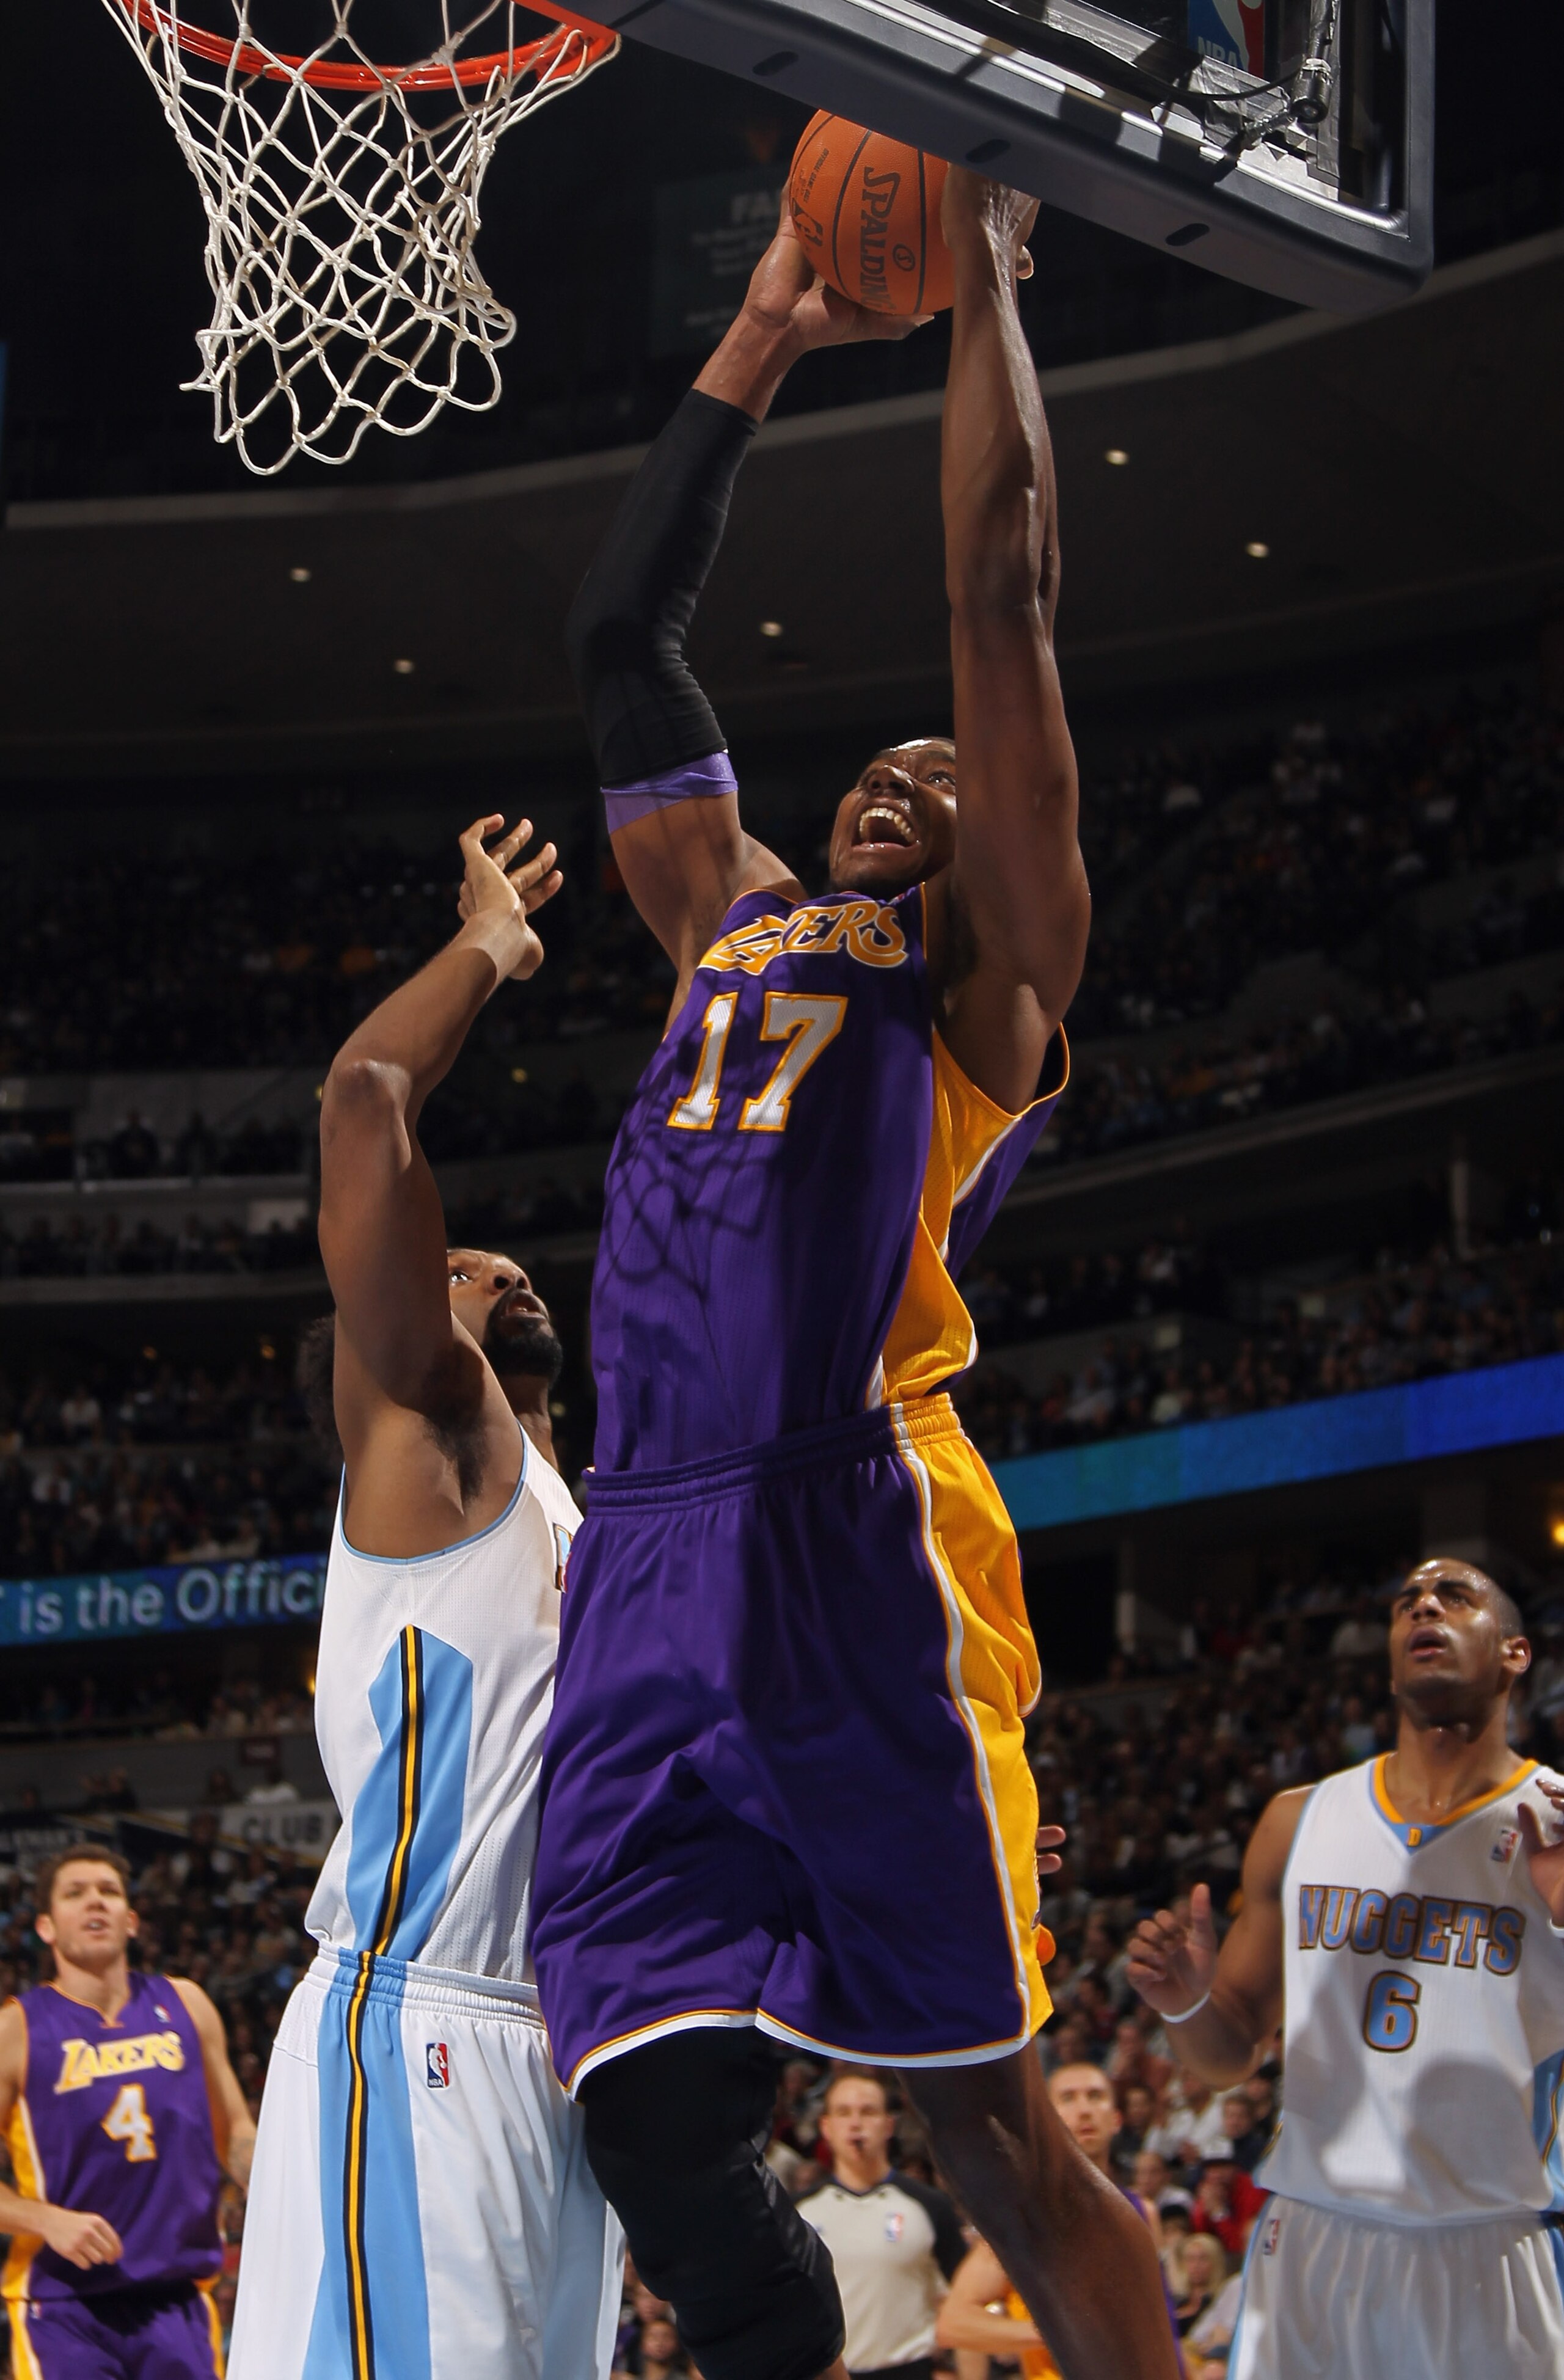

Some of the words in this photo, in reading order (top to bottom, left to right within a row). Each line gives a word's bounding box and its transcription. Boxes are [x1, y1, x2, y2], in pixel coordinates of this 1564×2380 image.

[860, 166, 901, 310] SPALDING
[697, 900, 908, 976] LAERS
[667, 991, 848, 1131] 17
[20, 1580, 63, 1634] is
[78, 1576, 164, 1630] the
[1299, 1884, 1526, 1976] NUGGETS
[1363, 1970, 1421, 2053] 6
[54, 2031, 185, 2094] LAKERS
[101, 2082, 157, 2163] 4
